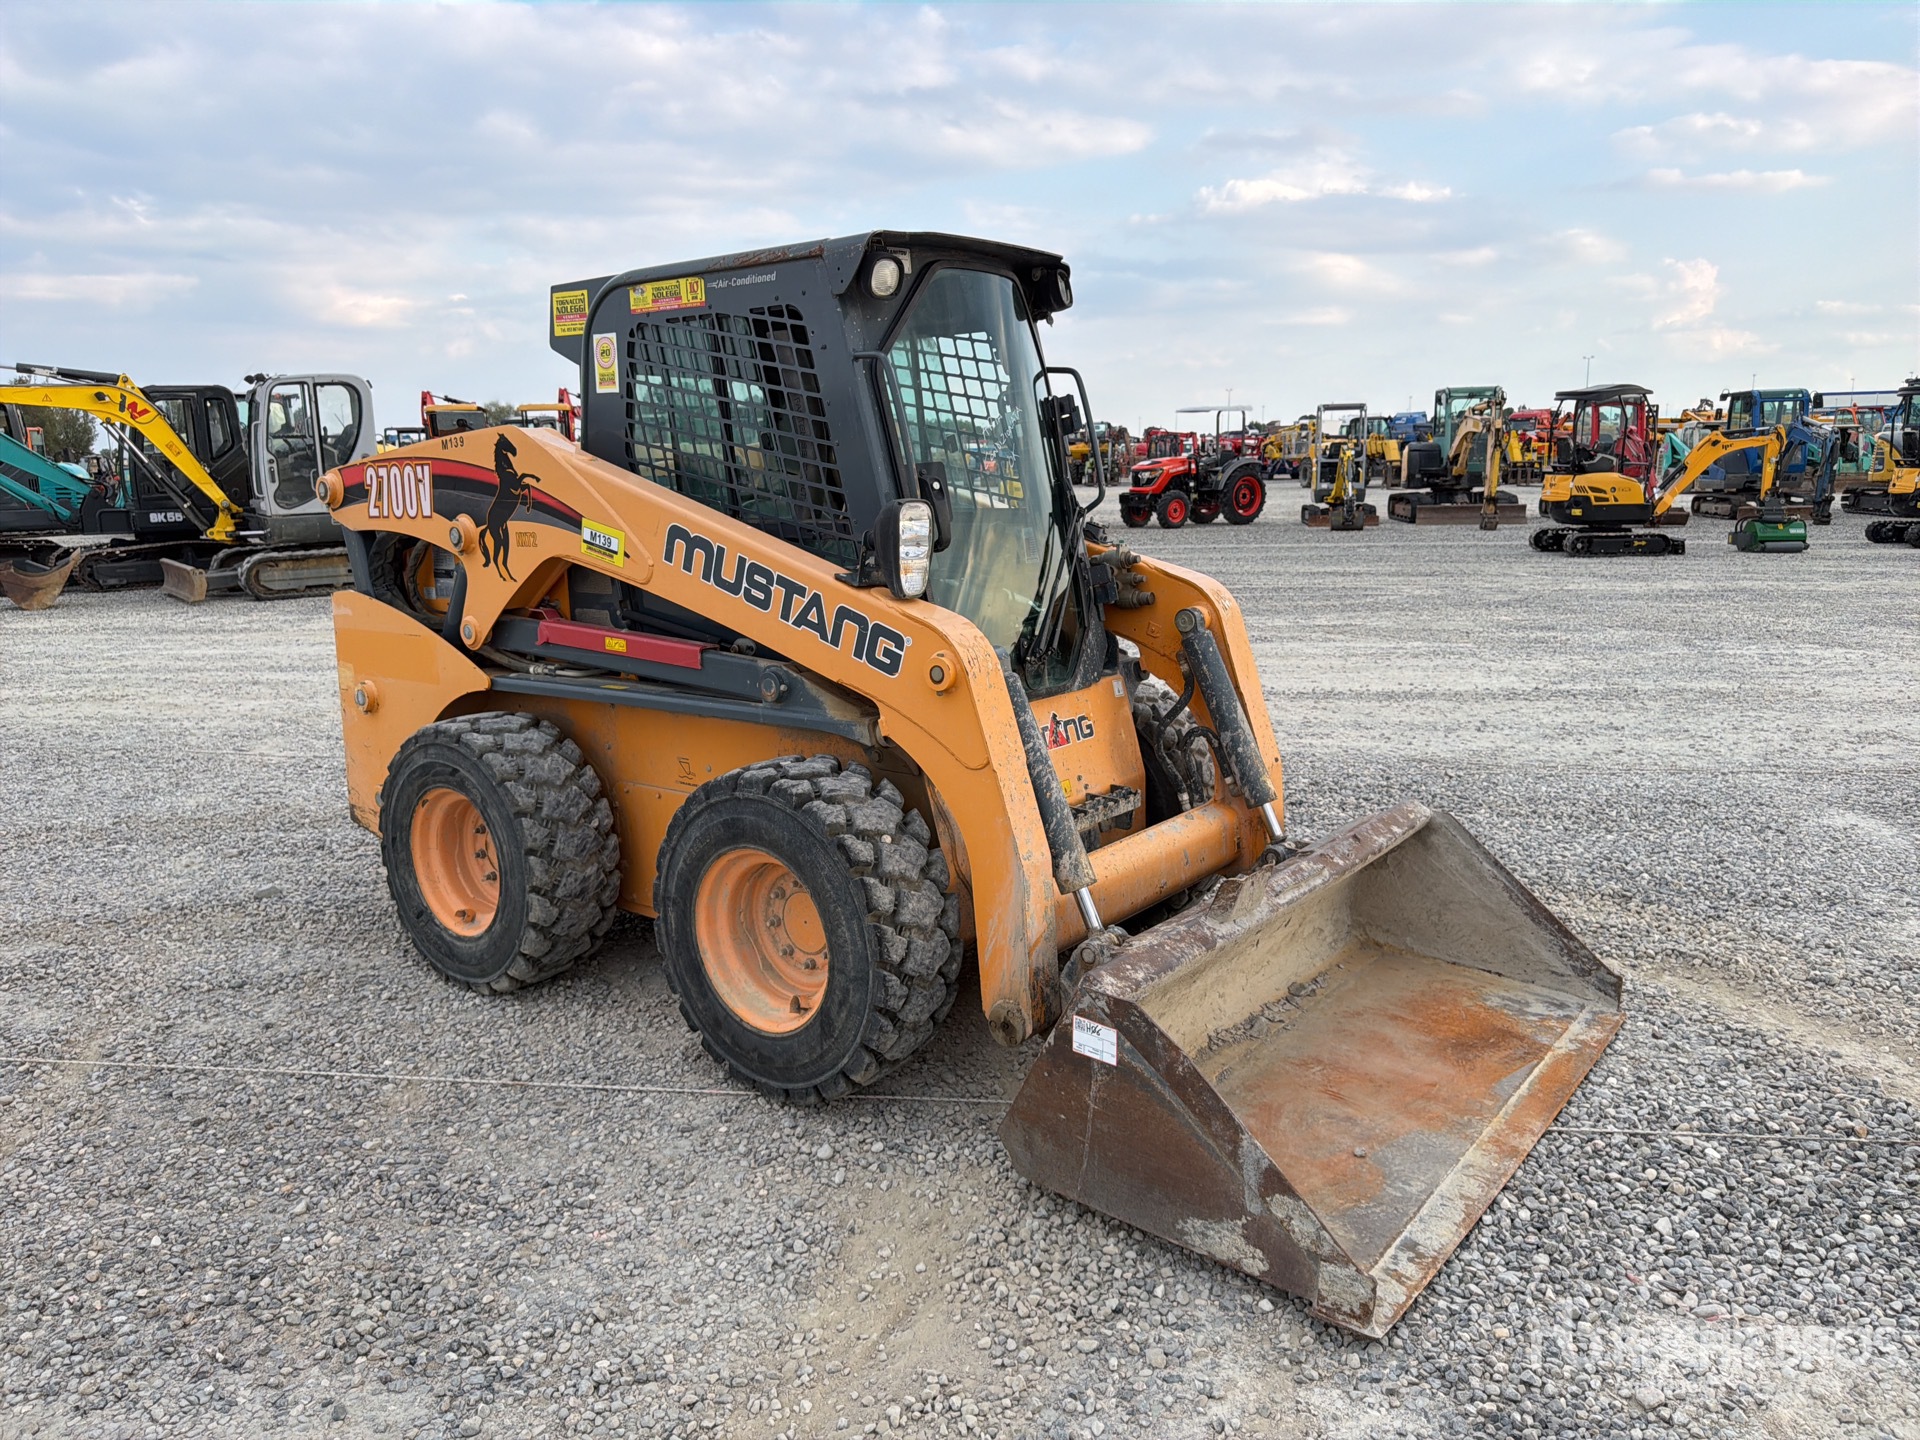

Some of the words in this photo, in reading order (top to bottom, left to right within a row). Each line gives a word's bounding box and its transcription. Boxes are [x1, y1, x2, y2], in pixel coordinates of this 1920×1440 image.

[717, 270, 777, 289] Air-Conditioned
[441, 435, 465, 451] M139
[364, 461, 433, 520] 2700V
[589, 529, 613, 548] M139
[663, 522, 905, 678] MUSTANG
